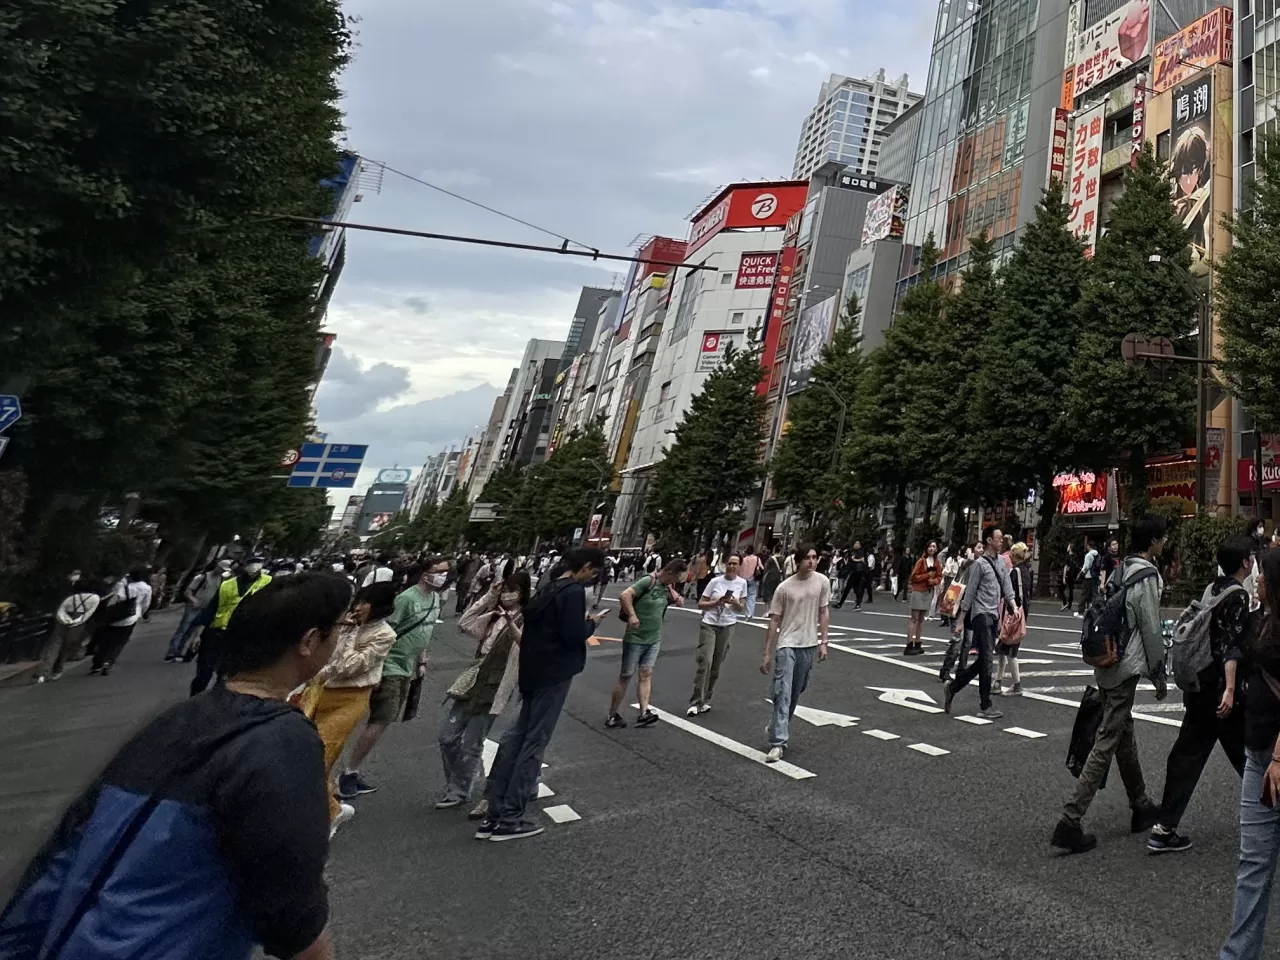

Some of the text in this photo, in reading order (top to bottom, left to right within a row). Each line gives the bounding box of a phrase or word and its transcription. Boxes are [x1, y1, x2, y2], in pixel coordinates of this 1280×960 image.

[1086, 15, 1121, 45] ハニトー
[1201, 12, 1219, 36] DVD
[1075, 58, 1118, 94] カラオケ
[1076, 45, 1119, 78] 曲数世界一
[1176, 83, 1208, 123] 鳴潮
[741, 265, 777, 274] Tax Free
[742, 256, 773, 266] QUICK
